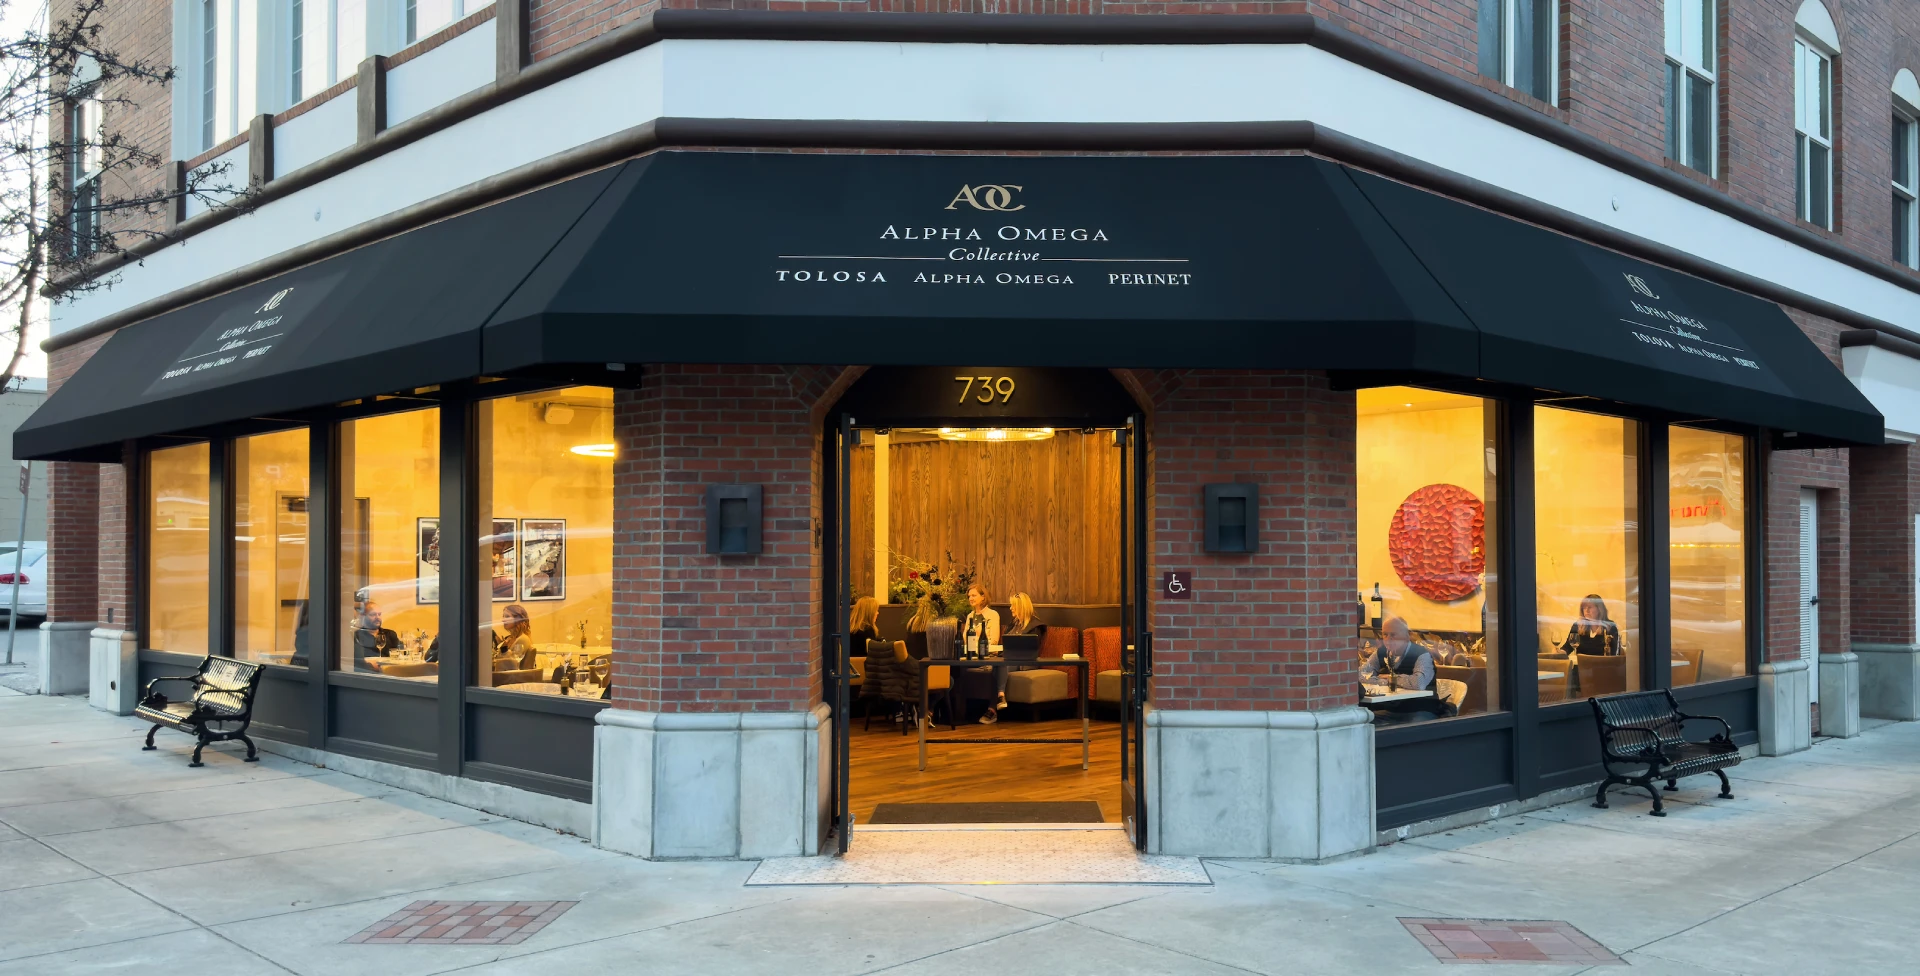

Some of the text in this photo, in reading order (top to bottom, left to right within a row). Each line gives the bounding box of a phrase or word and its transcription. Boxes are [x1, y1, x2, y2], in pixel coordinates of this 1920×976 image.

[879, 224, 1109, 242] ALPHA OMEGA
[948, 247, 1040, 262] Collective
[775, 270, 1192, 285] TOLOSA ALPHA OMEGA PERINET
[1632, 331, 1675, 349] TOLOSA
[955, 376, 1015, 403] 739
